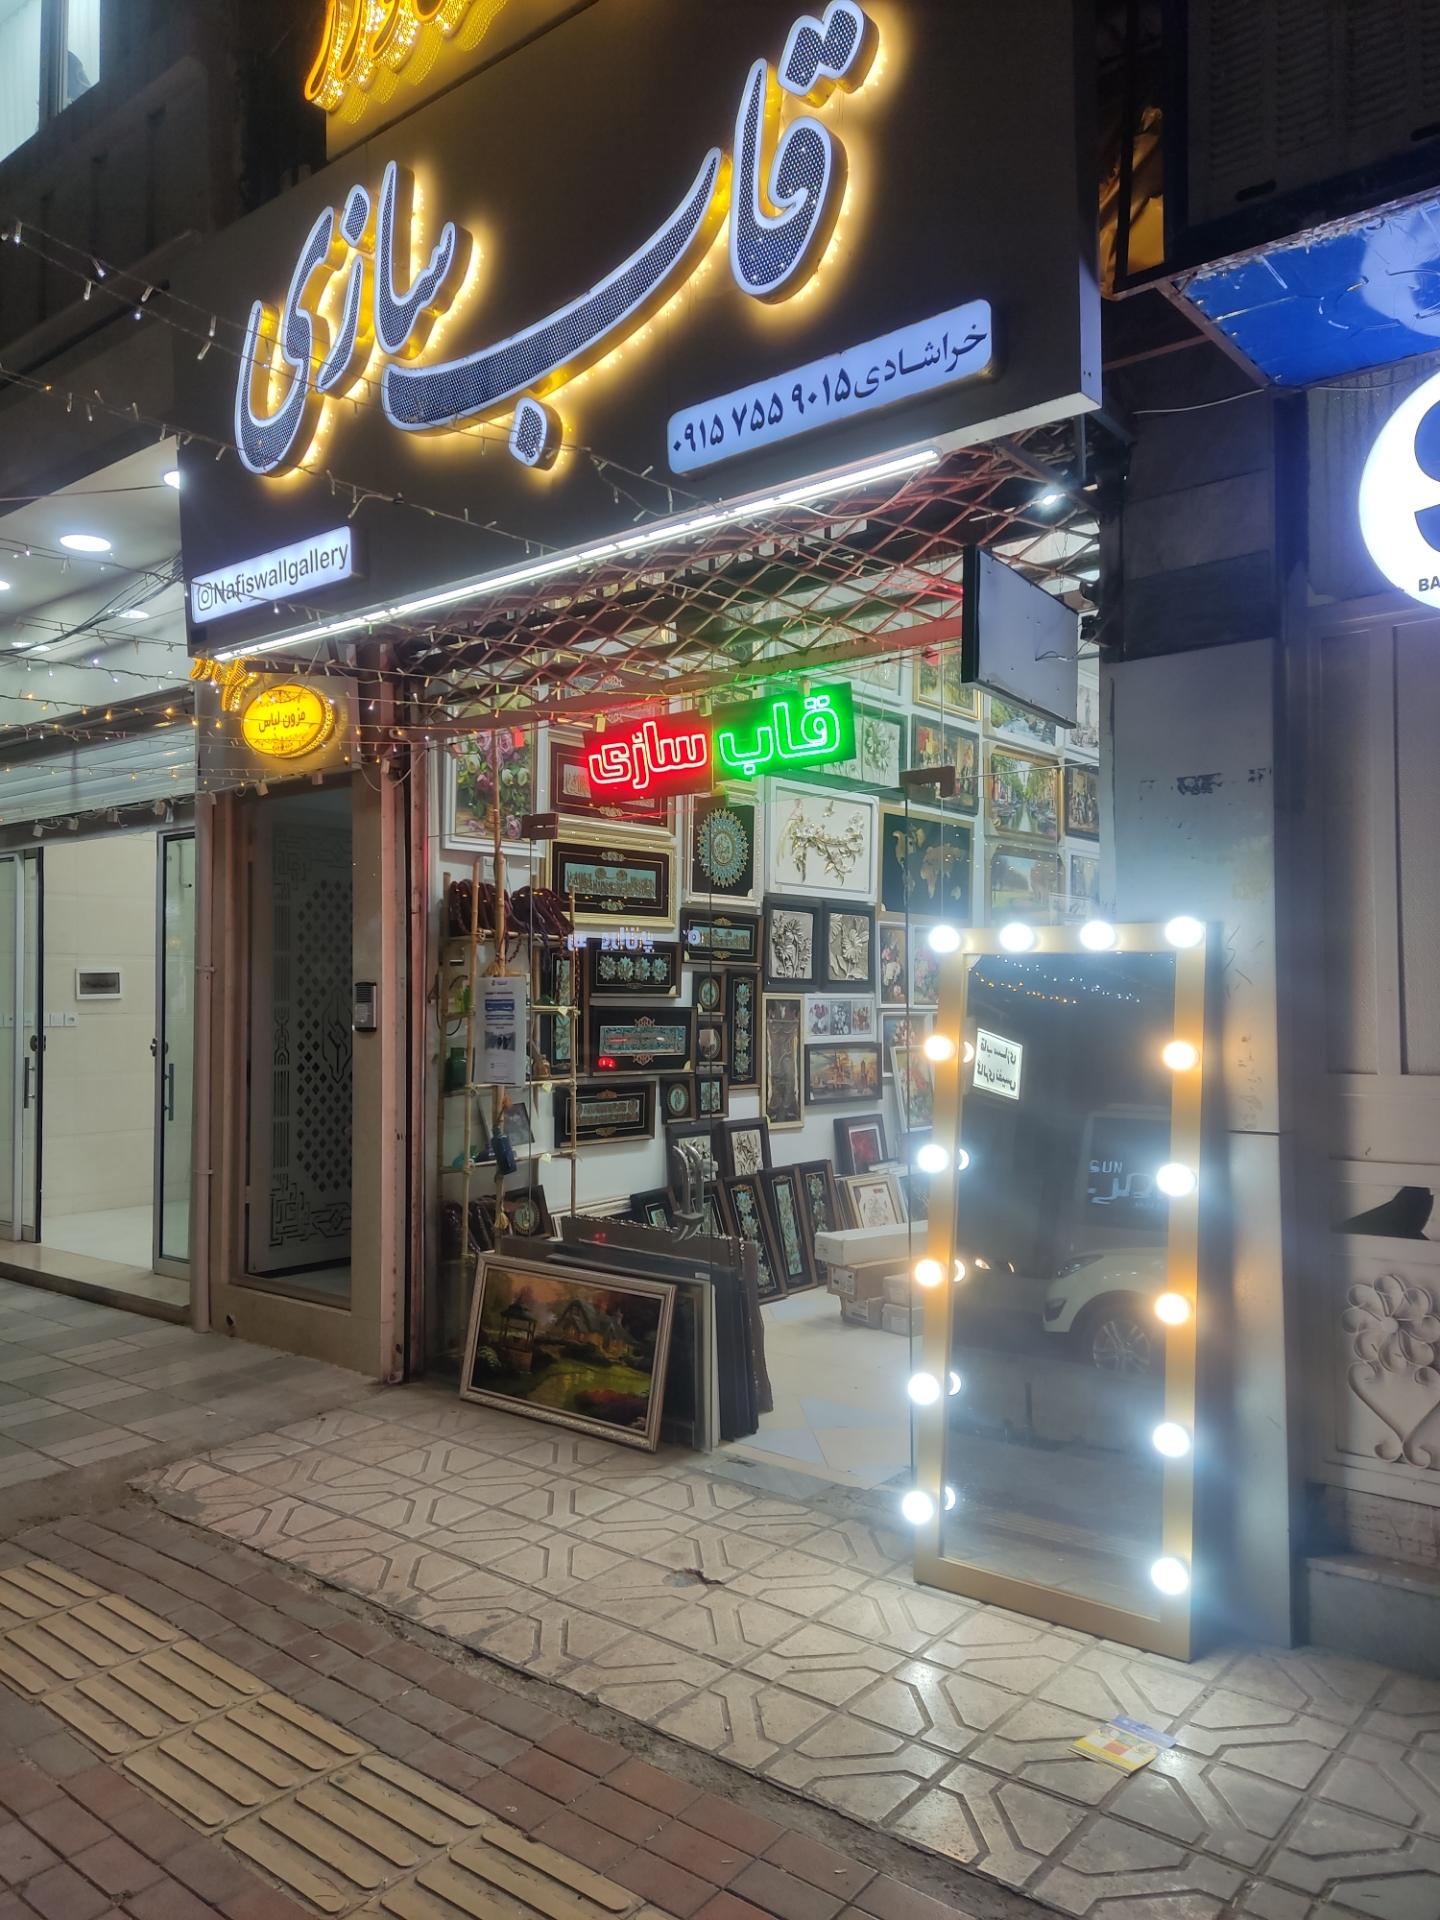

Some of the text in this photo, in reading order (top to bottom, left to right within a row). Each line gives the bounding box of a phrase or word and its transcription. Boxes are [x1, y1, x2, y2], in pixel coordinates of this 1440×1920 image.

[234, 0, 867, 475] قاب سازی
[673, 323, 988, 452] خراشادی ۰۹۱۵ ۷۵۵ ۹۰۱۵
[213, 543, 349, 605] Nafiswallgallery
[588, 695, 840, 790] قاب سازی
